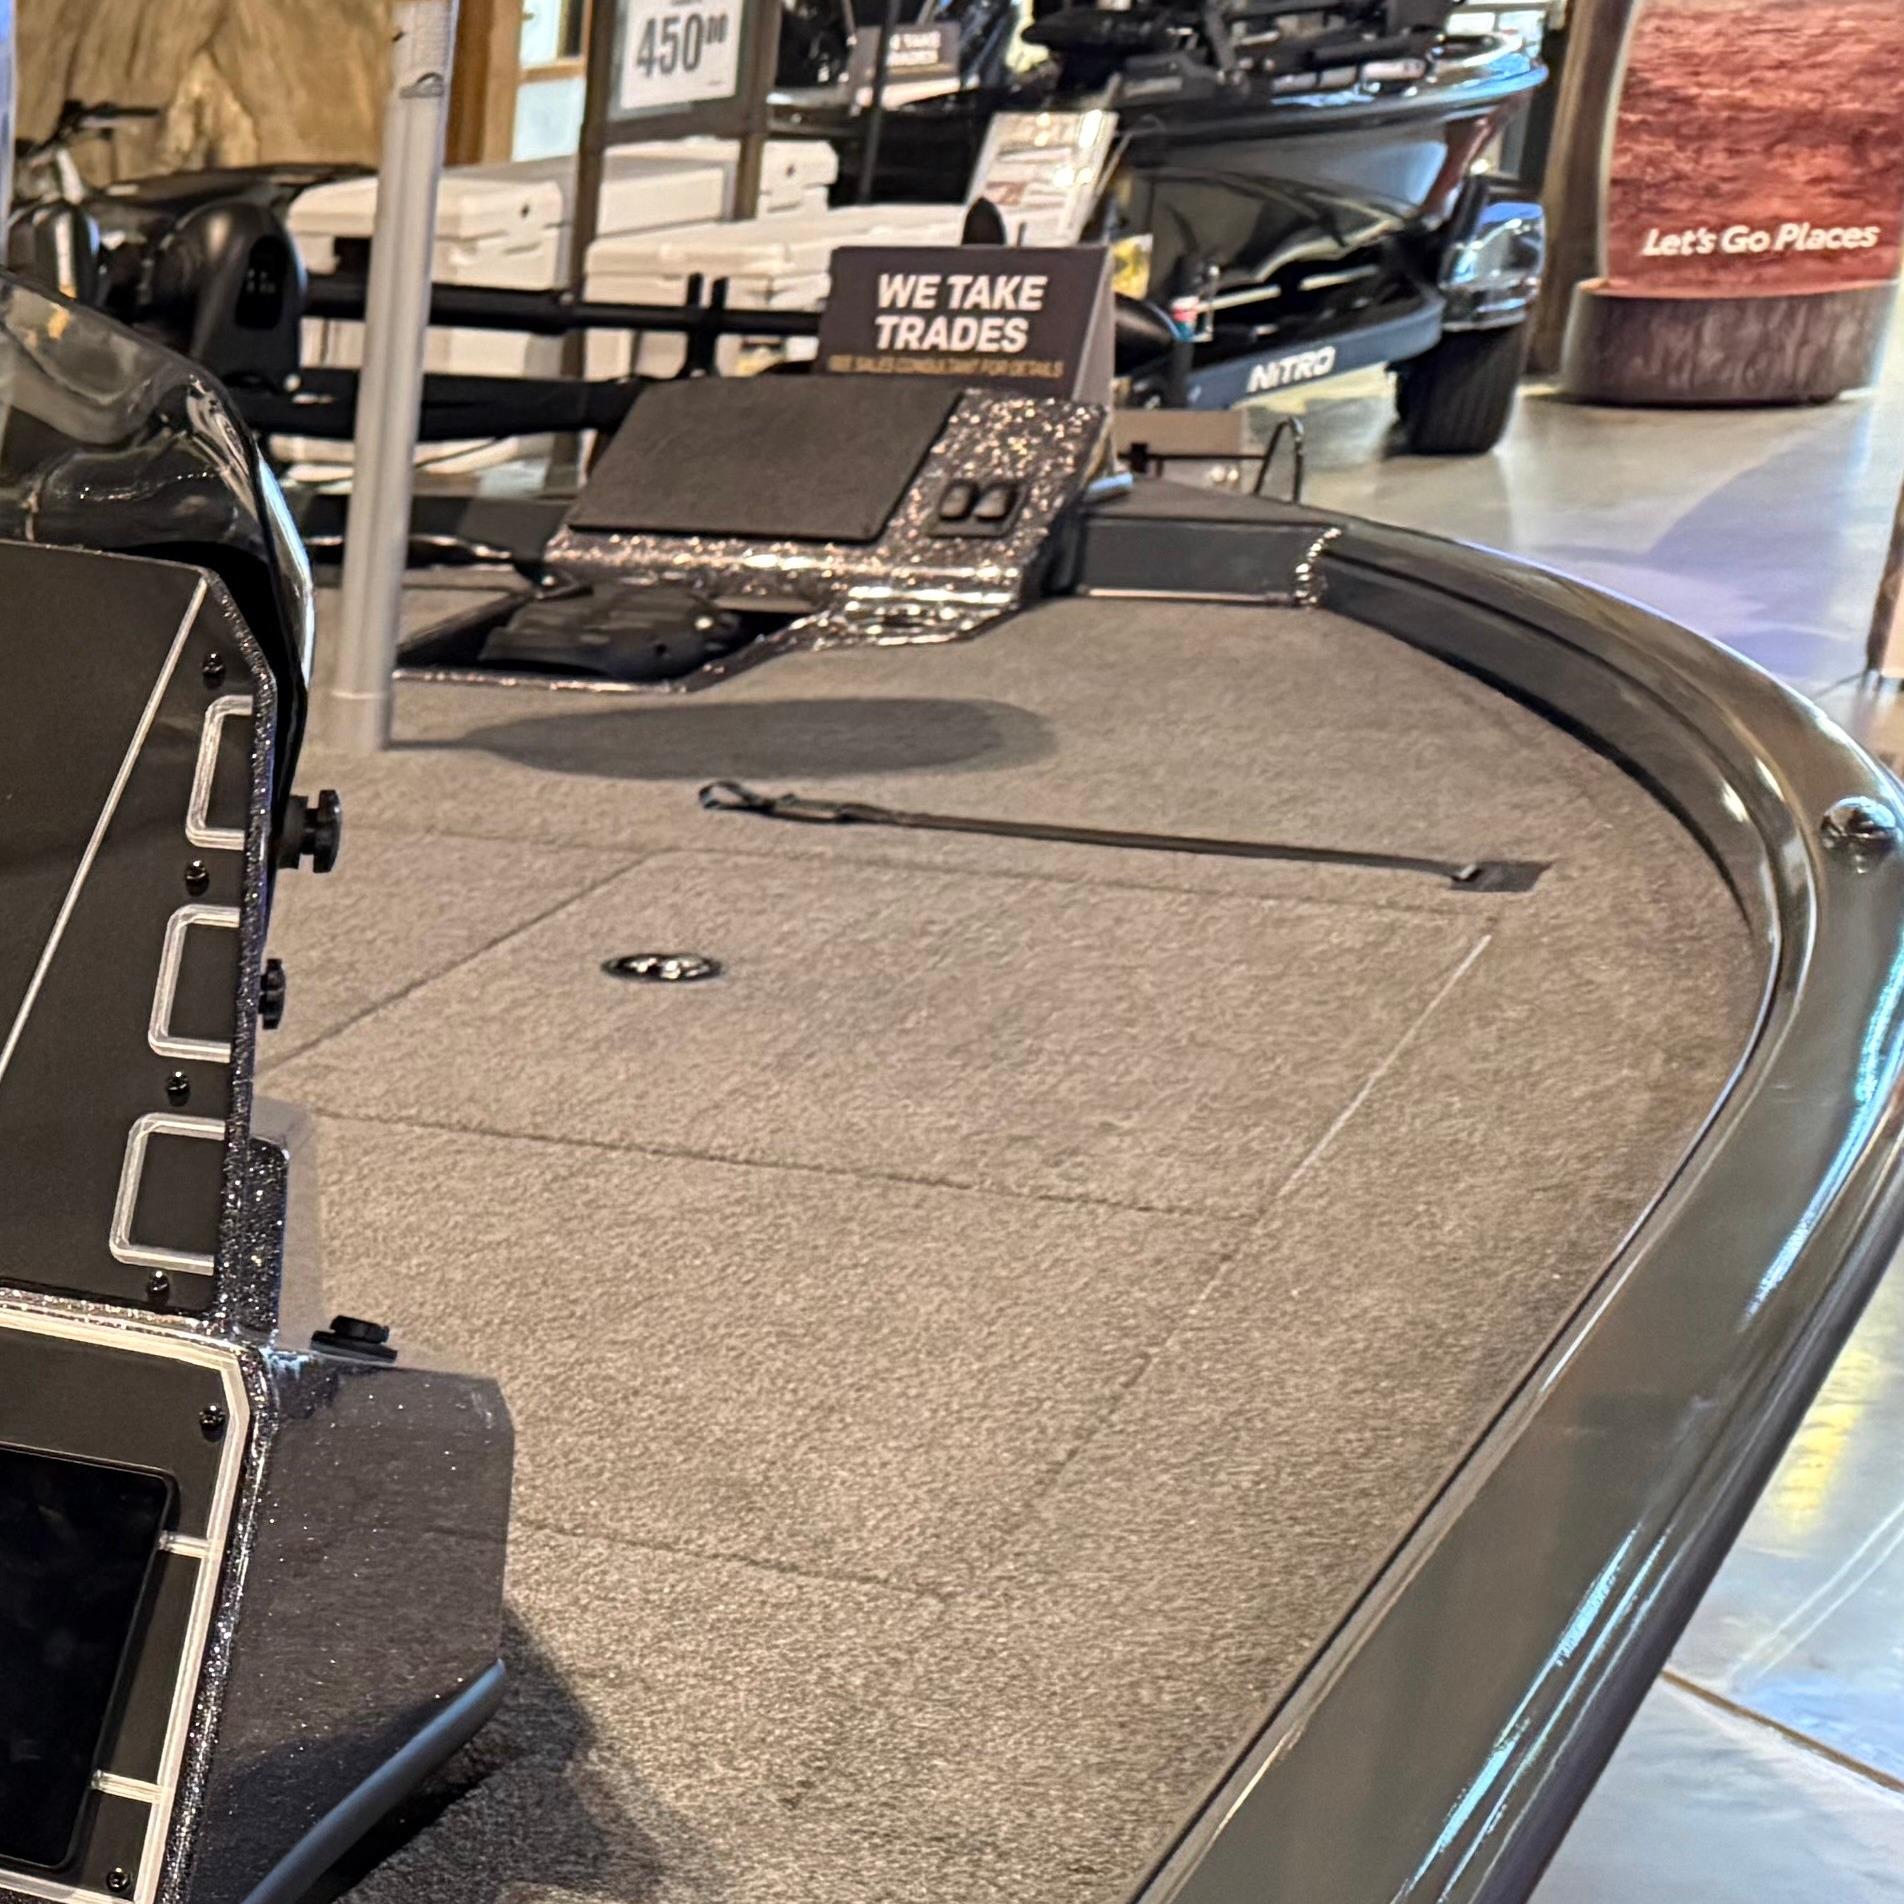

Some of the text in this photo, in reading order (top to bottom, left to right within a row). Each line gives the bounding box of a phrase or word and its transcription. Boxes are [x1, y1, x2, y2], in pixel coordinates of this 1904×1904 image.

[1641, 221, 1882, 257] Let's Go Places
[876, 273, 1048, 312] WE TAKE
[873, 315, 1030, 353] TRADES
[1247, 346, 1336, 393] NITRO
